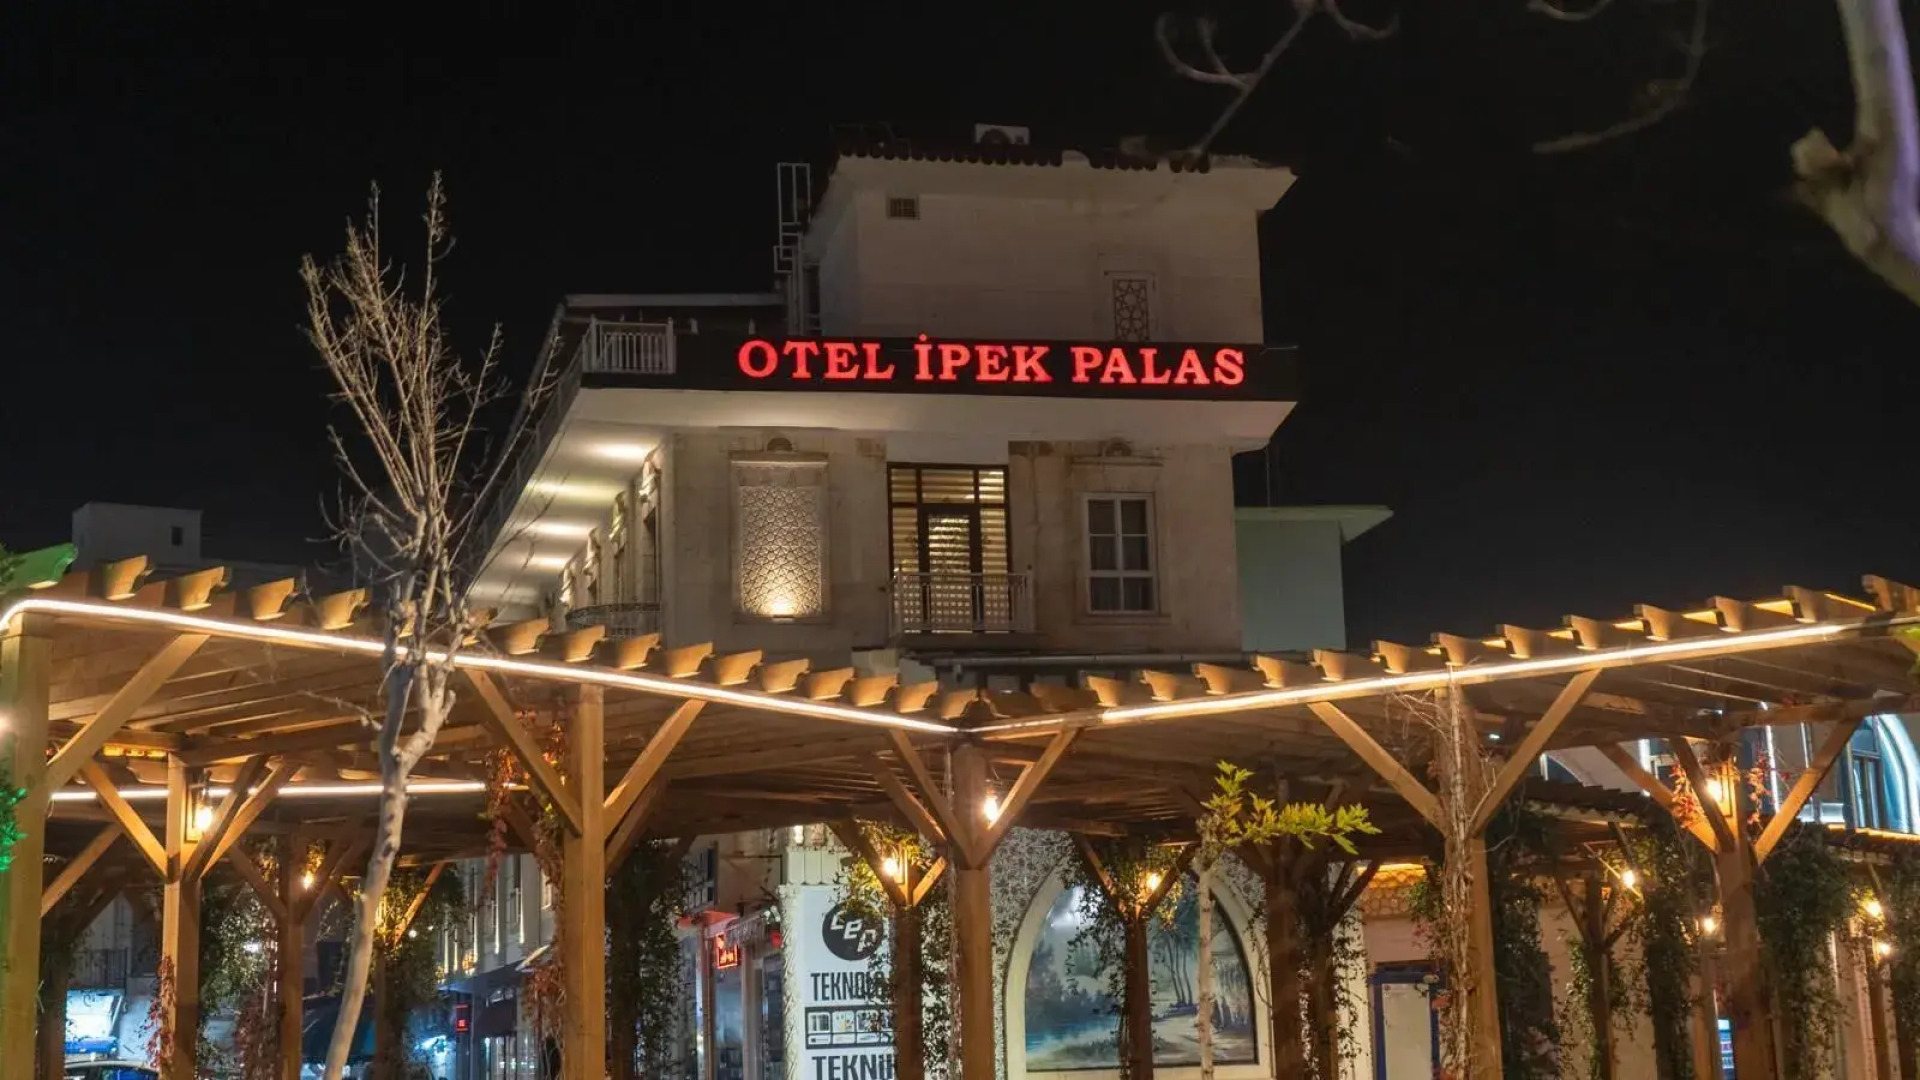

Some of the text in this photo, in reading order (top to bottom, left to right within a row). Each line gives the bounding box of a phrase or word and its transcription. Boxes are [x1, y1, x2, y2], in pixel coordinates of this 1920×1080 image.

[737, 334, 1245, 386] OTEL İPEK PALAS
